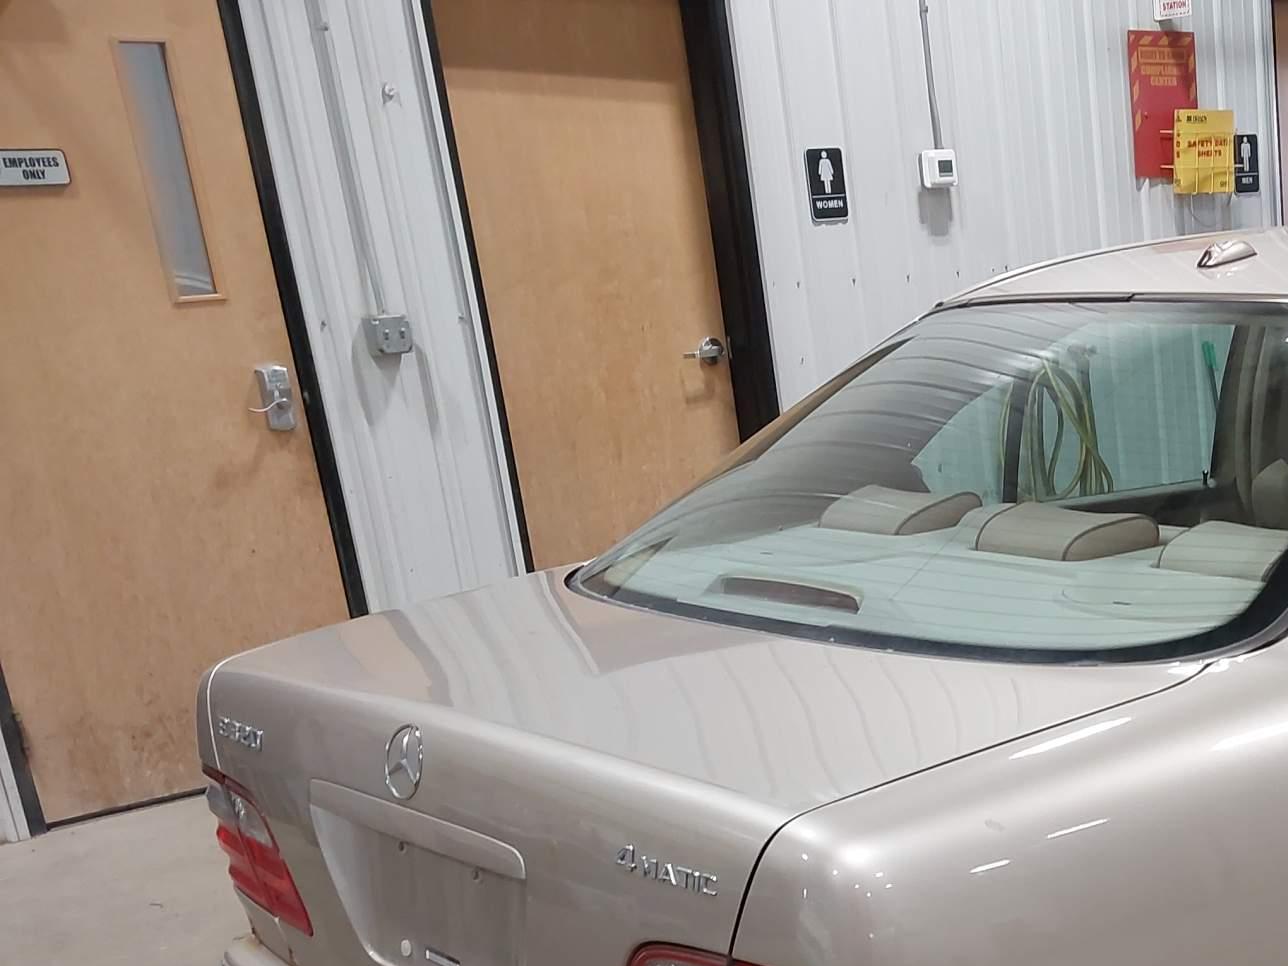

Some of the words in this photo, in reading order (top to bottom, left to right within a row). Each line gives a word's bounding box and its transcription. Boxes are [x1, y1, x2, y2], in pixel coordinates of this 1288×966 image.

[1162, 1, 1186, 11] STATION
[2, 156, 59, 169] EMPLOYEES
[22, 169, 46, 180] ONLY
[1241, 177, 1253, 185] MEN
[815, 199, 844, 209] WOMEN
